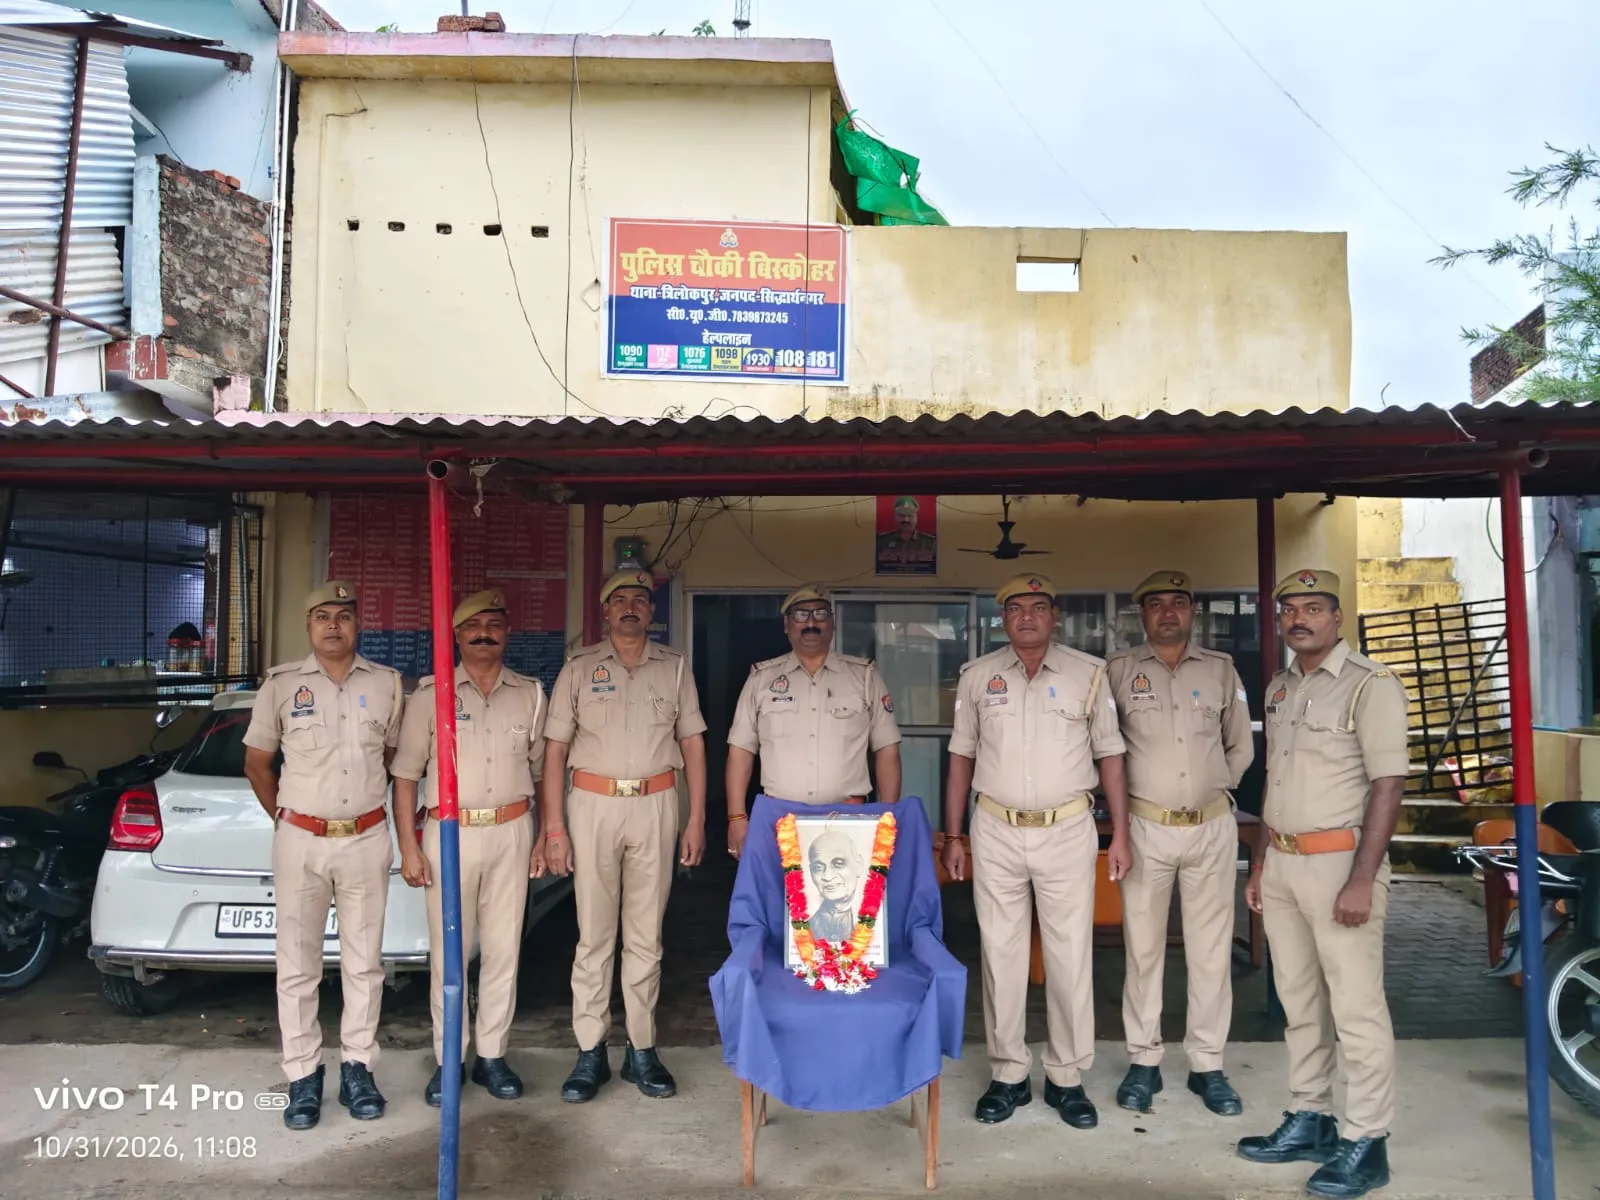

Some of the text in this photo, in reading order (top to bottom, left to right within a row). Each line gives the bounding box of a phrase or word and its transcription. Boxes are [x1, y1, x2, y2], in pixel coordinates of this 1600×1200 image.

[620, 247, 685, 282] पुलिस
[688, 248, 745, 278] चौकी
[702, 328, 752, 346] हेल्पलाइन
[620, 345, 643, 356] 1090
[684, 347, 706, 358] 1076
[715, 348, 738, 359] 1098
[746, 353, 770, 366] 1930
[777, 349, 805, 367] 108
[808, 350, 836, 368] 181
[232, 910, 277, 929] UP53
